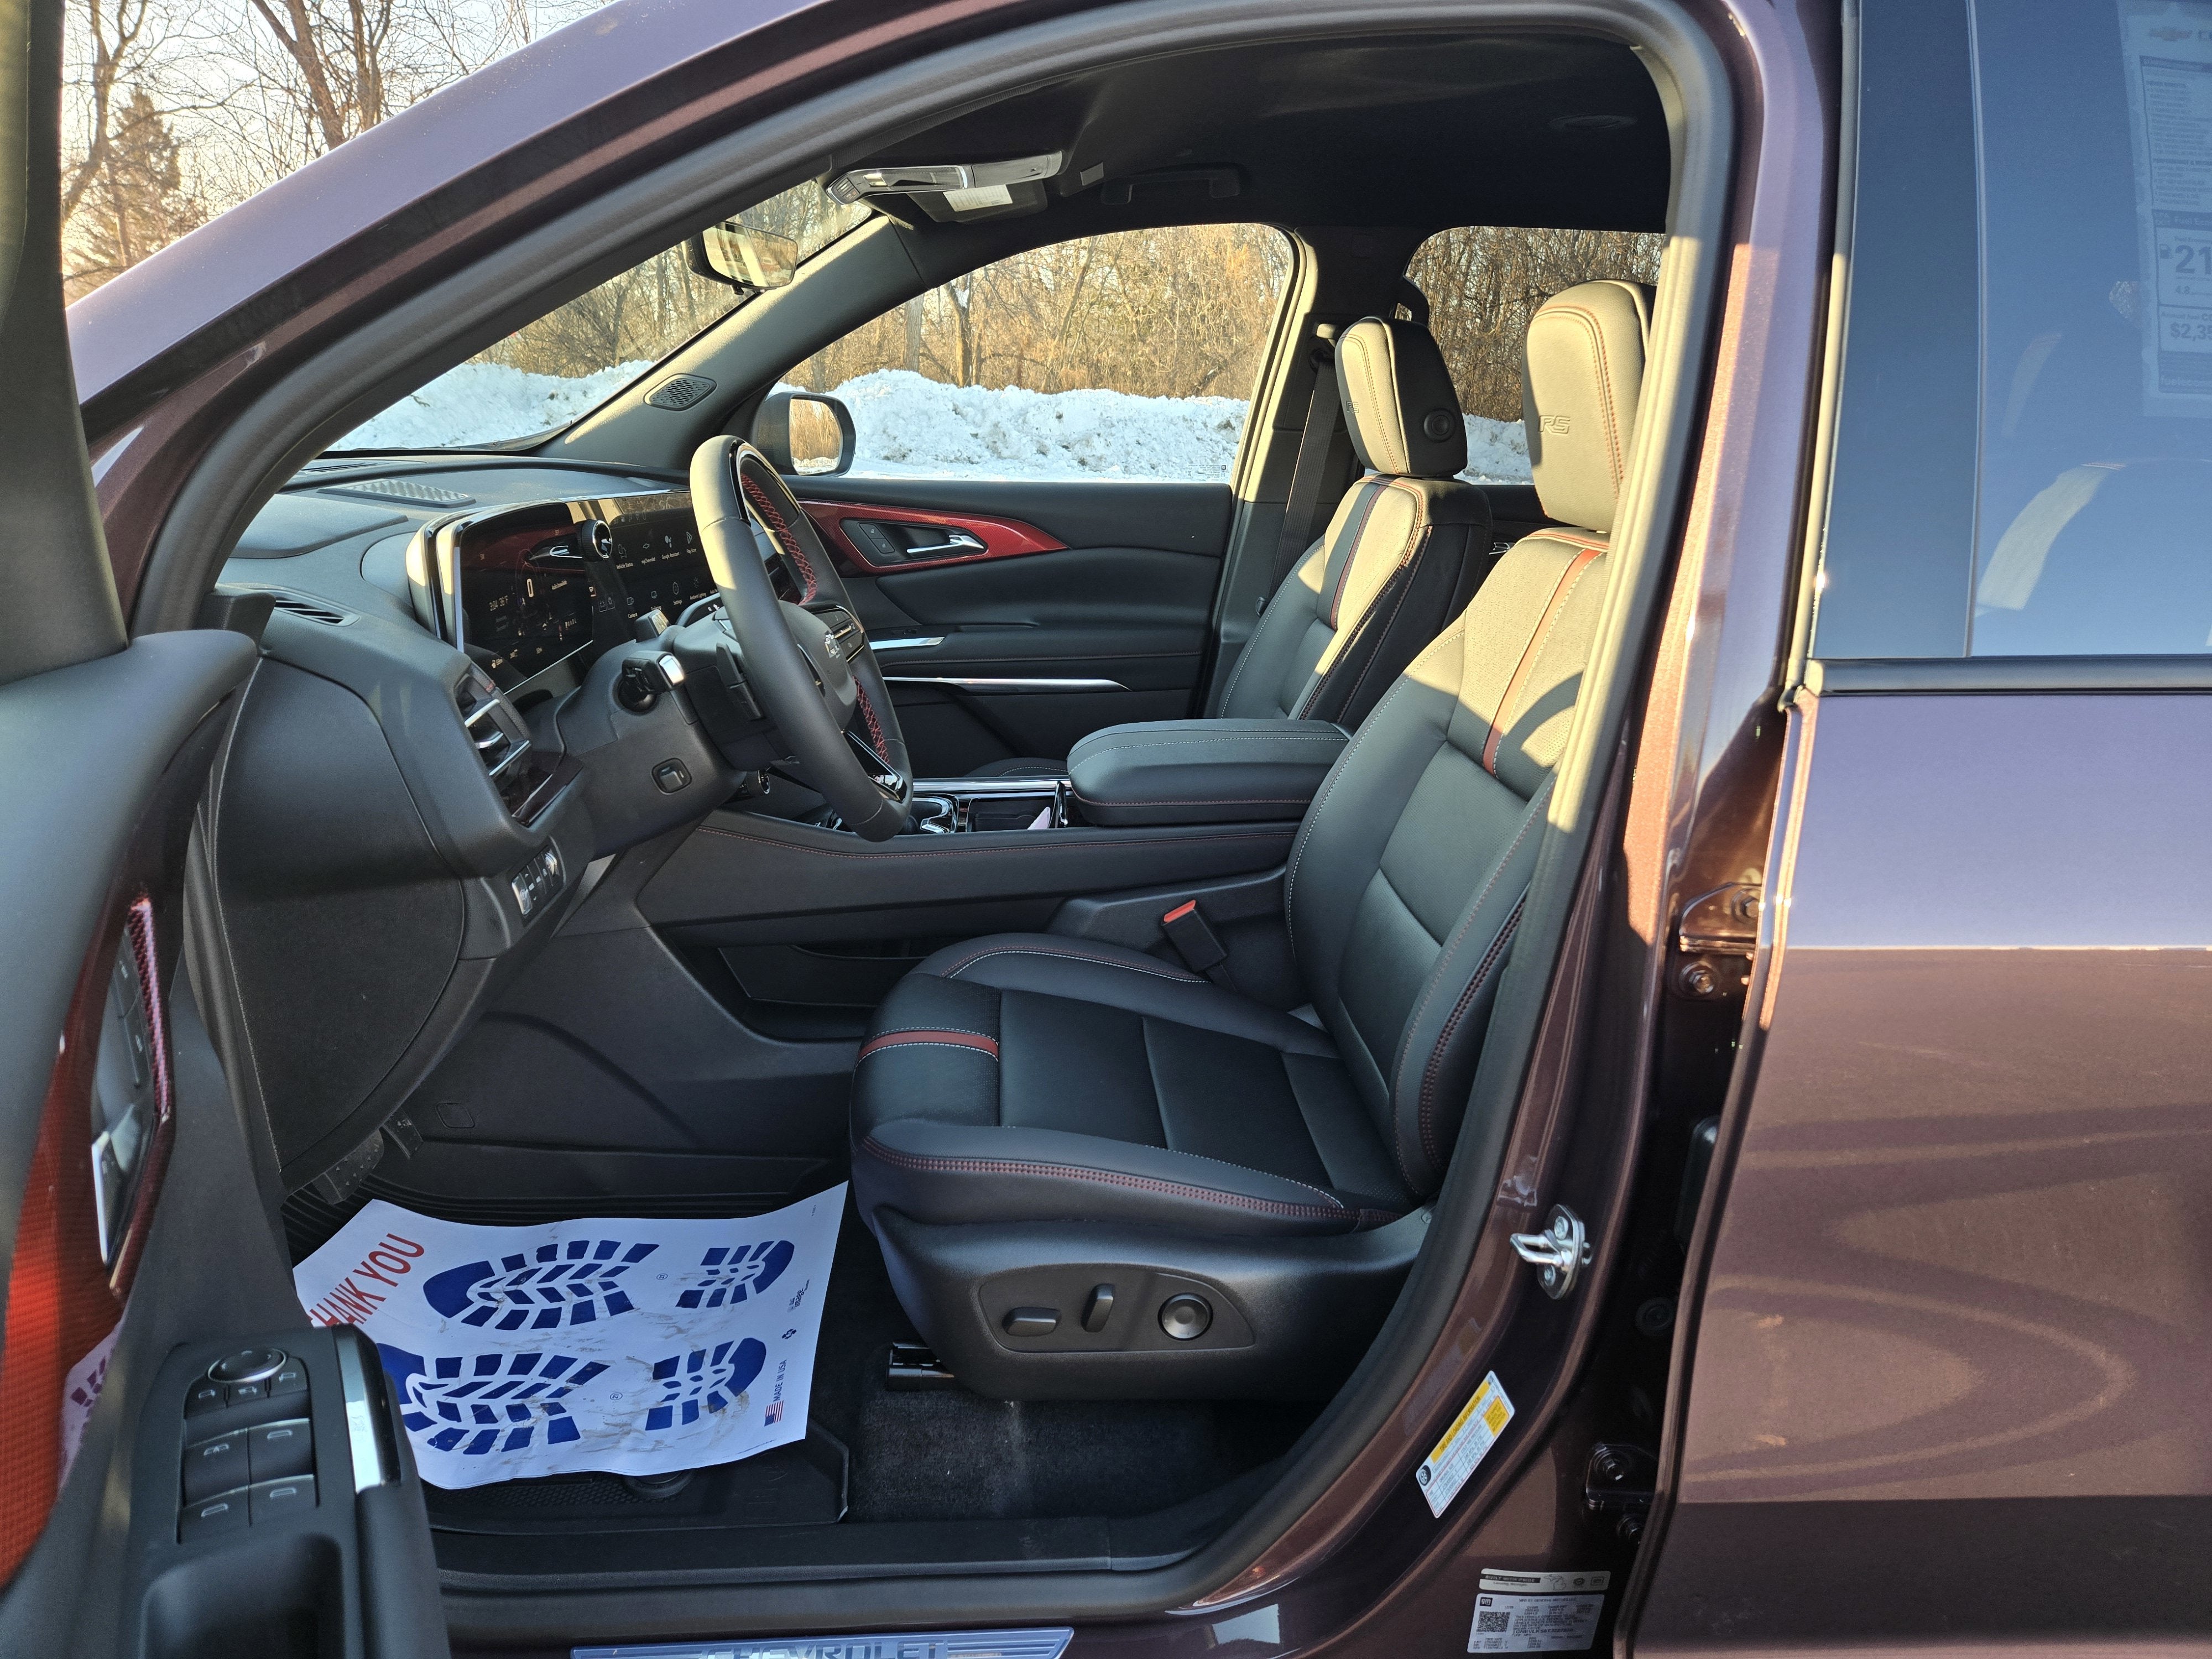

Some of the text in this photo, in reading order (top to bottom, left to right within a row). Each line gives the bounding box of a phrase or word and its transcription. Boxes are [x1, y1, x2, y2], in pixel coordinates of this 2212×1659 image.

[1538, 415, 1571, 435] RS
[306, 1233, 425, 1327] HANK YOU
[773, 1359, 787, 1402] MADE IN USA
